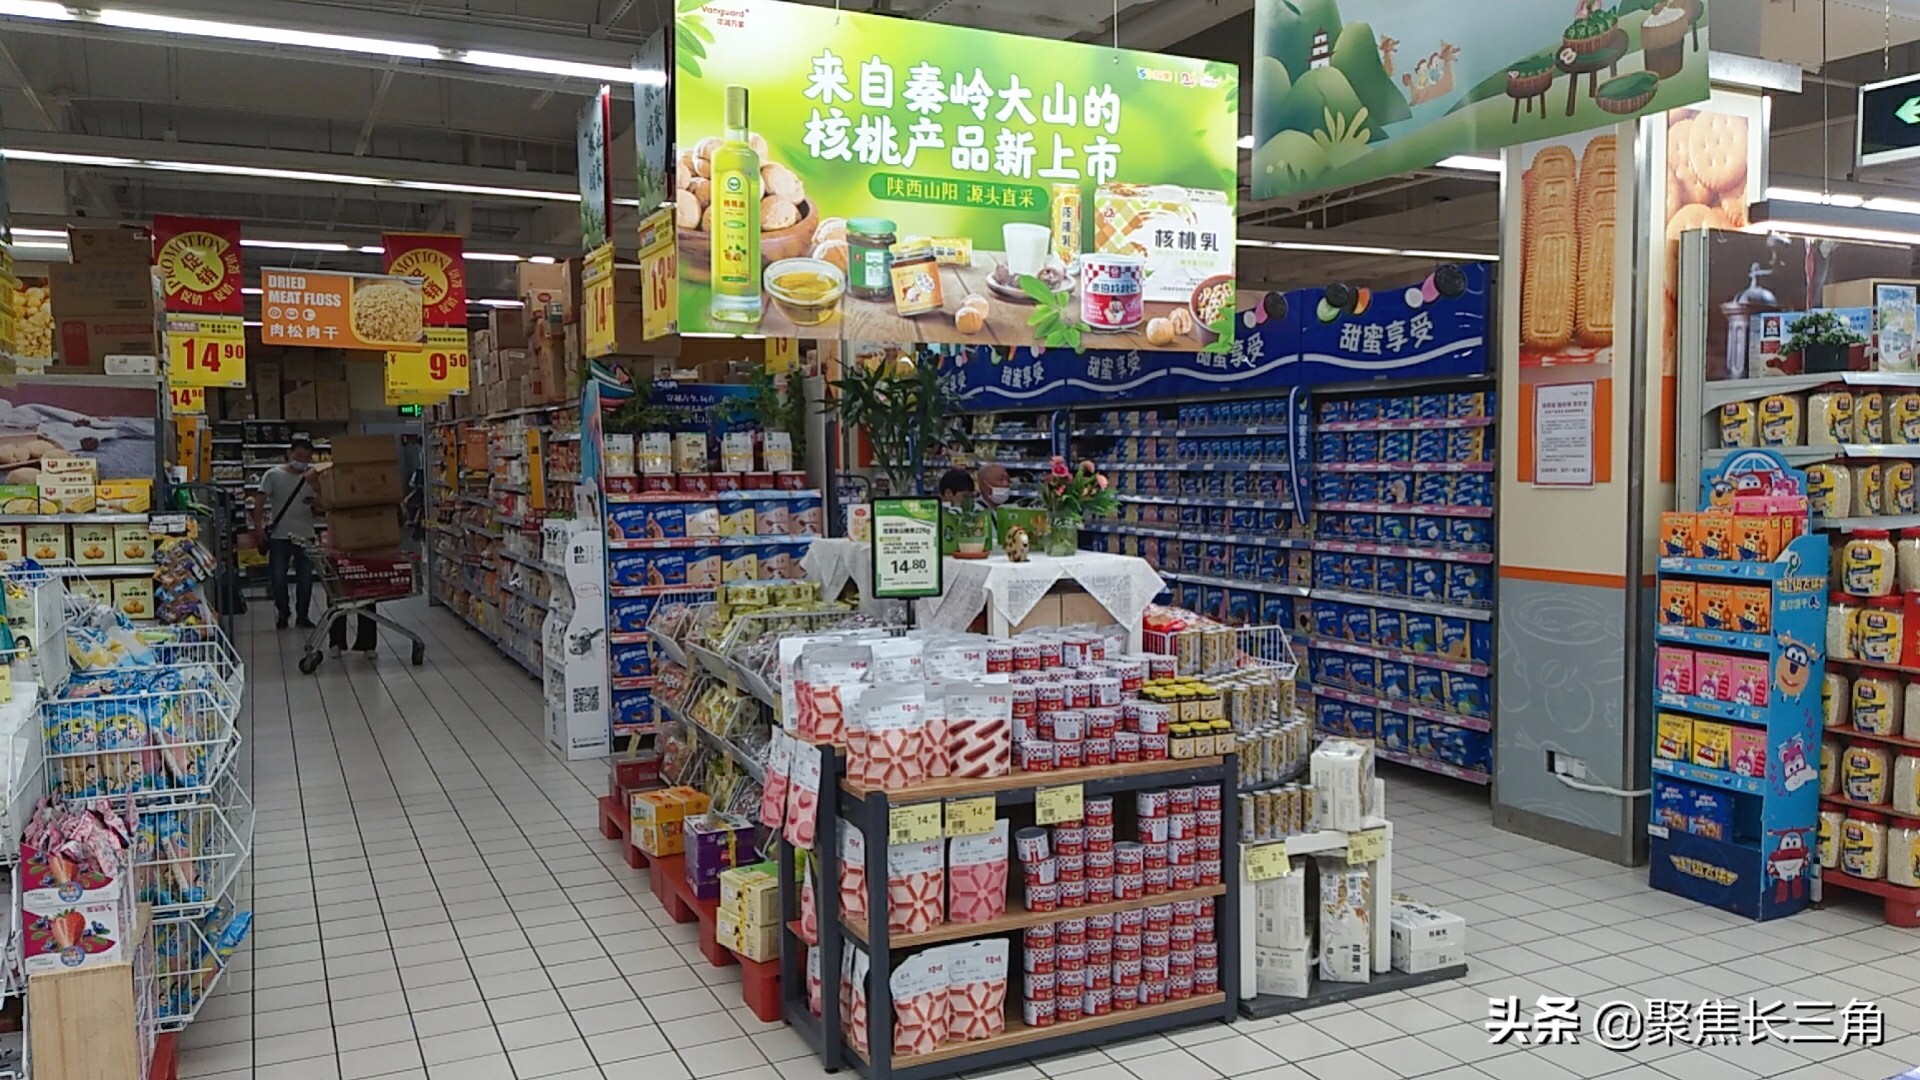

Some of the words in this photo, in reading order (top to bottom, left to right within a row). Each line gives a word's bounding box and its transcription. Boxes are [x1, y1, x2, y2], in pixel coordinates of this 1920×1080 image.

[803, 47, 1122, 134] 来自秦岭大山的
[803, 106, 1122, 185] 核桃产品新上市
[886, 176, 959, 201] 陕西山阳
[966, 183, 1035, 208] 源头直采
[1154, 228, 1219, 252] 核桃乳
[161, 234, 221, 290] PROMOTION
[181, 251, 219, 286] 促销
[393, 250, 448, 276] MOTION
[267, 289, 302, 305] MEAT
[303, 291, 342, 308] FLOSS
[268, 274, 307, 291] DRIED
[269, 322, 340, 341] 肉松肉干
[1339, 312, 1435, 355] 甜蜜享受
[1087, 349, 1142, 382] 甜蜜享受
